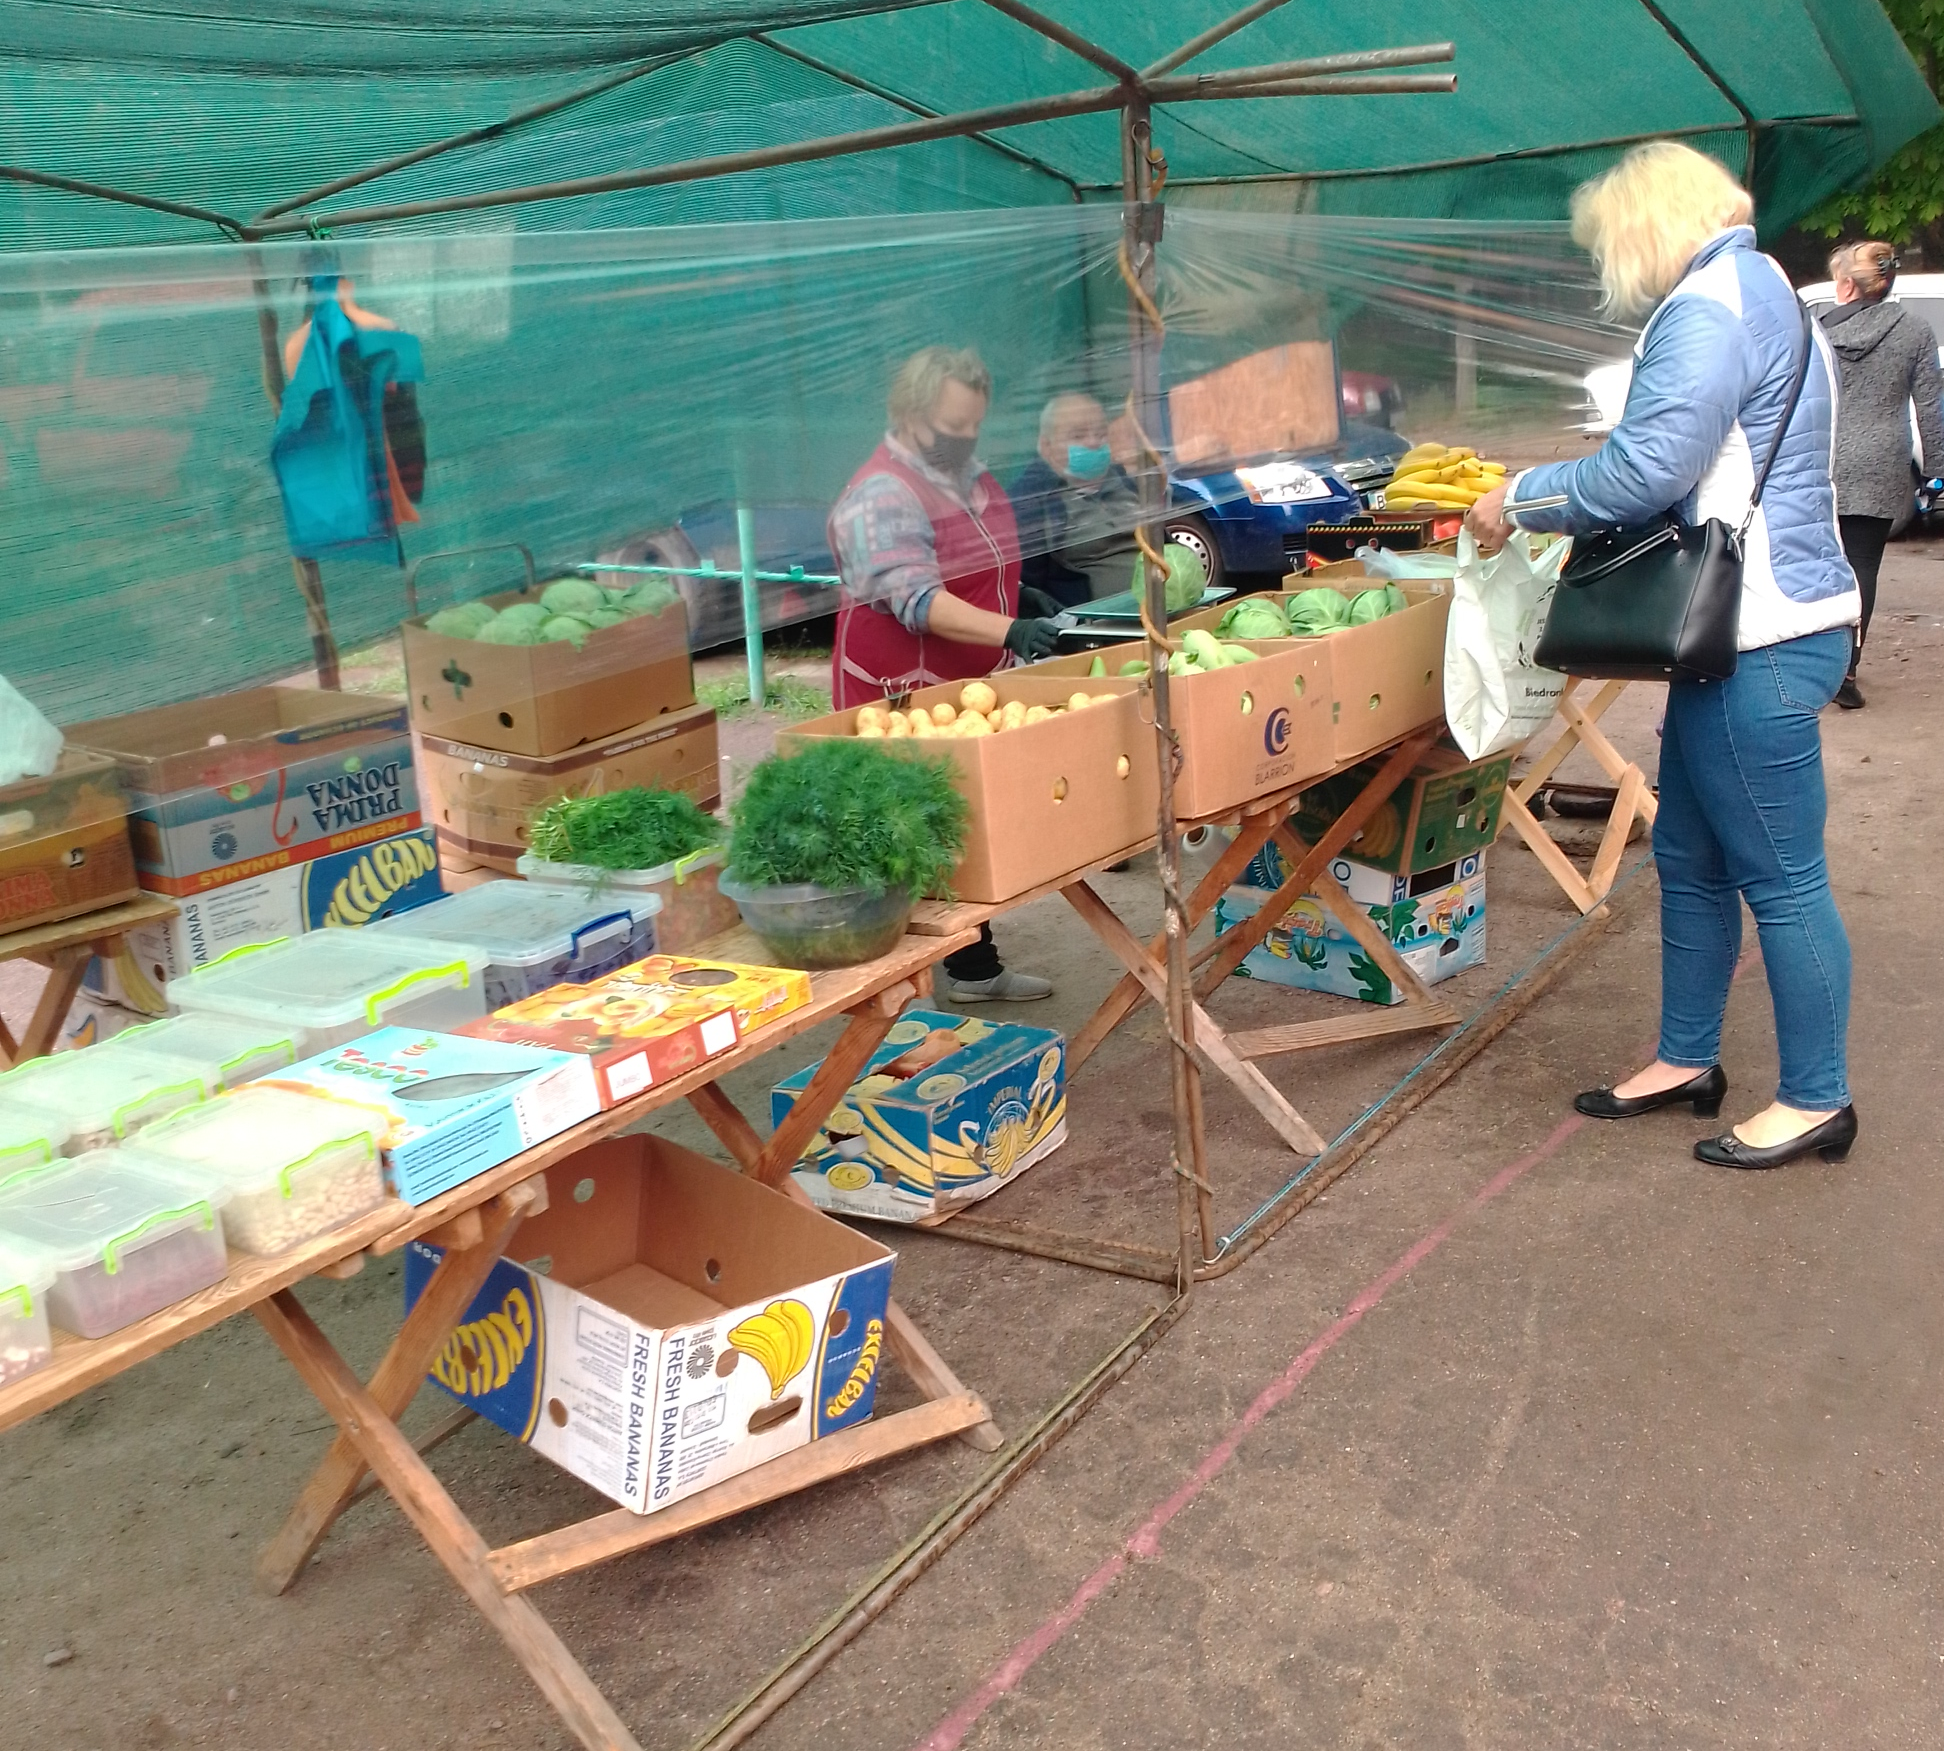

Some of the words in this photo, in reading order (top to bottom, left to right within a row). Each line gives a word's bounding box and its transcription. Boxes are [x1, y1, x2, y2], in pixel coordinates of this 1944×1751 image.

[448, 744, 509, 768] BANANAS
[306, 761, 400, 806] DONNA
[312, 788, 404, 832] PRIMA
[330, 818, 409, 850] PREMIUM
[200, 850, 290, 887] BANANAS
[987, 1085, 1023, 1116] IMPERIAL
[631, 1331, 651, 1399] FRESH
[663, 1337, 686, 1403] FRESH
[825, 1317, 883, 1419] EXCELBAN
[624, 1402, 645, 1498] BANANAS
[653, 1406, 679, 1501] BANANAS
